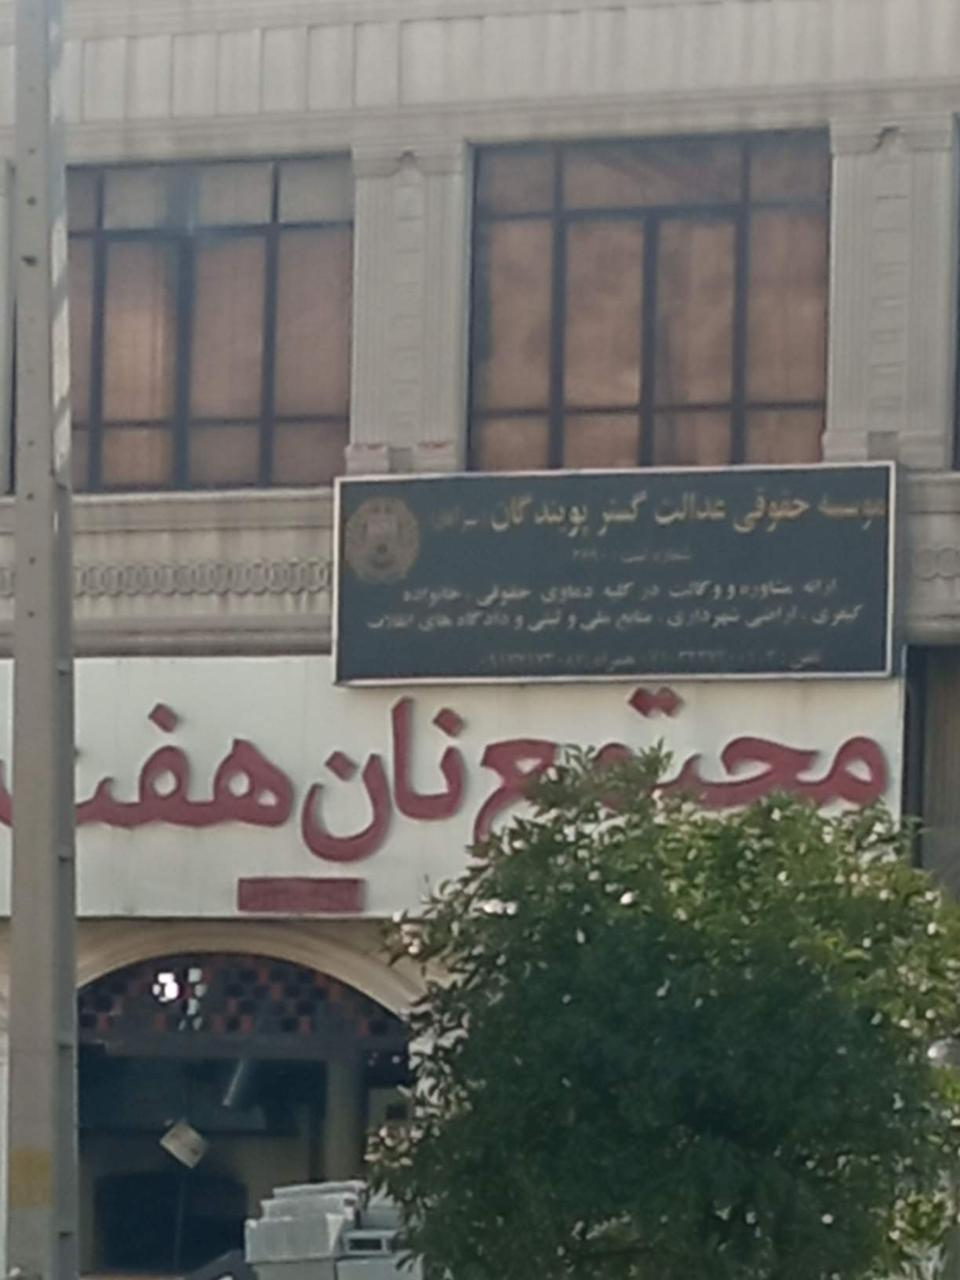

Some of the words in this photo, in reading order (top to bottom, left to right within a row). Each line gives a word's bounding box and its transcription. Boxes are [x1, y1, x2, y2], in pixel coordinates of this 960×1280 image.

[654, 492, 726, 525] عدالت
[733, 486, 809, 533] حقوقی
[300, 696, 465, 863] نان
